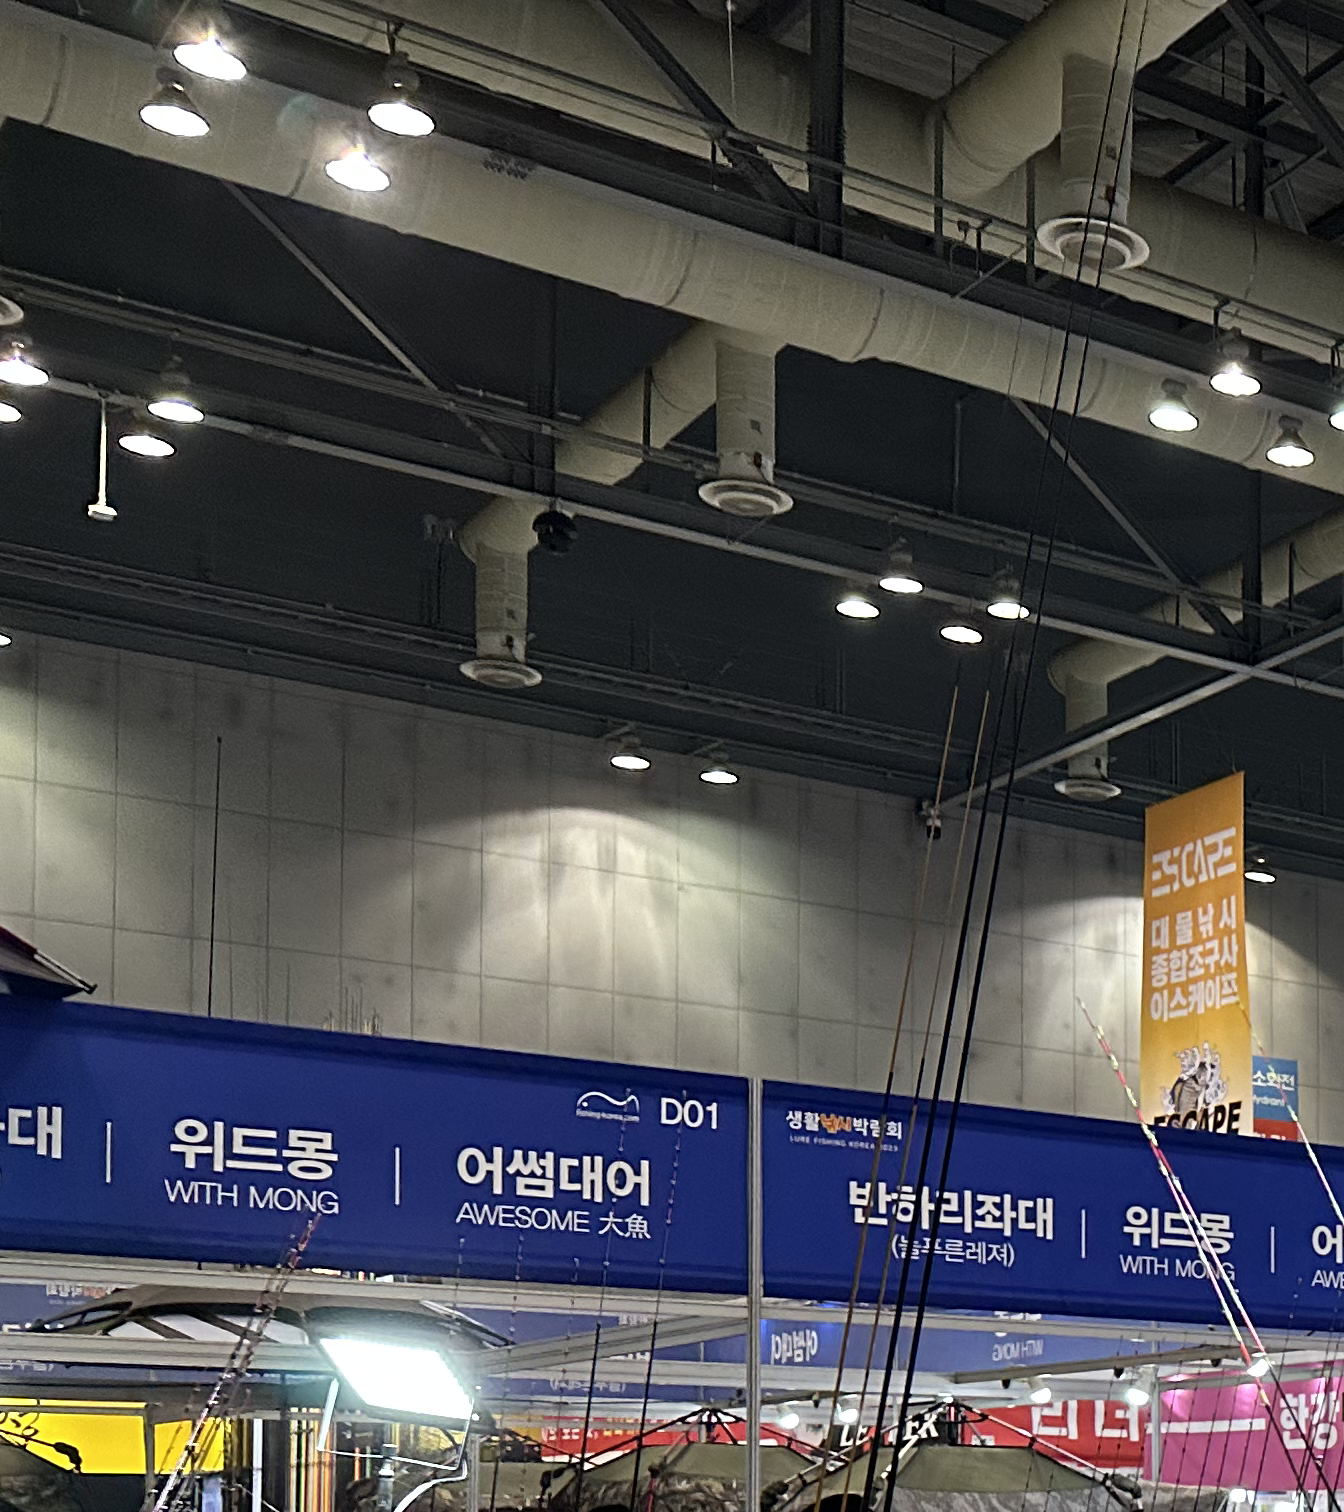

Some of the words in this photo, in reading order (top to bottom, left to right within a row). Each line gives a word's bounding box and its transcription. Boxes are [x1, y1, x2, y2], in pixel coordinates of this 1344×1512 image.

[1150, 933, 1239, 988] 종합조구사
[1150, 971, 1239, 1023] 이스케이프
[659, 1097, 719, 1130] D01
[0, 1106, 63, 1160] 대
[169, 1118, 339, 1181] 위드몽
[456, 1146, 651, 1207] 어썸대어
[163, 1178, 239, 1207] WITH
[249, 1185, 340, 1214] MONG
[455, 1201, 591, 1233] AWESOME
[598, 1211, 652, 1240] 大魚
[848, 1180, 1055, 1241] 반하리좌대
[1122, 1205, 1235, 1255] 위드몽
[1119, 1254, 1169, 1277] WITH
[1175, 1258, 1237, 1283] MONG
[840, 1413, 939, 1448] LEER
